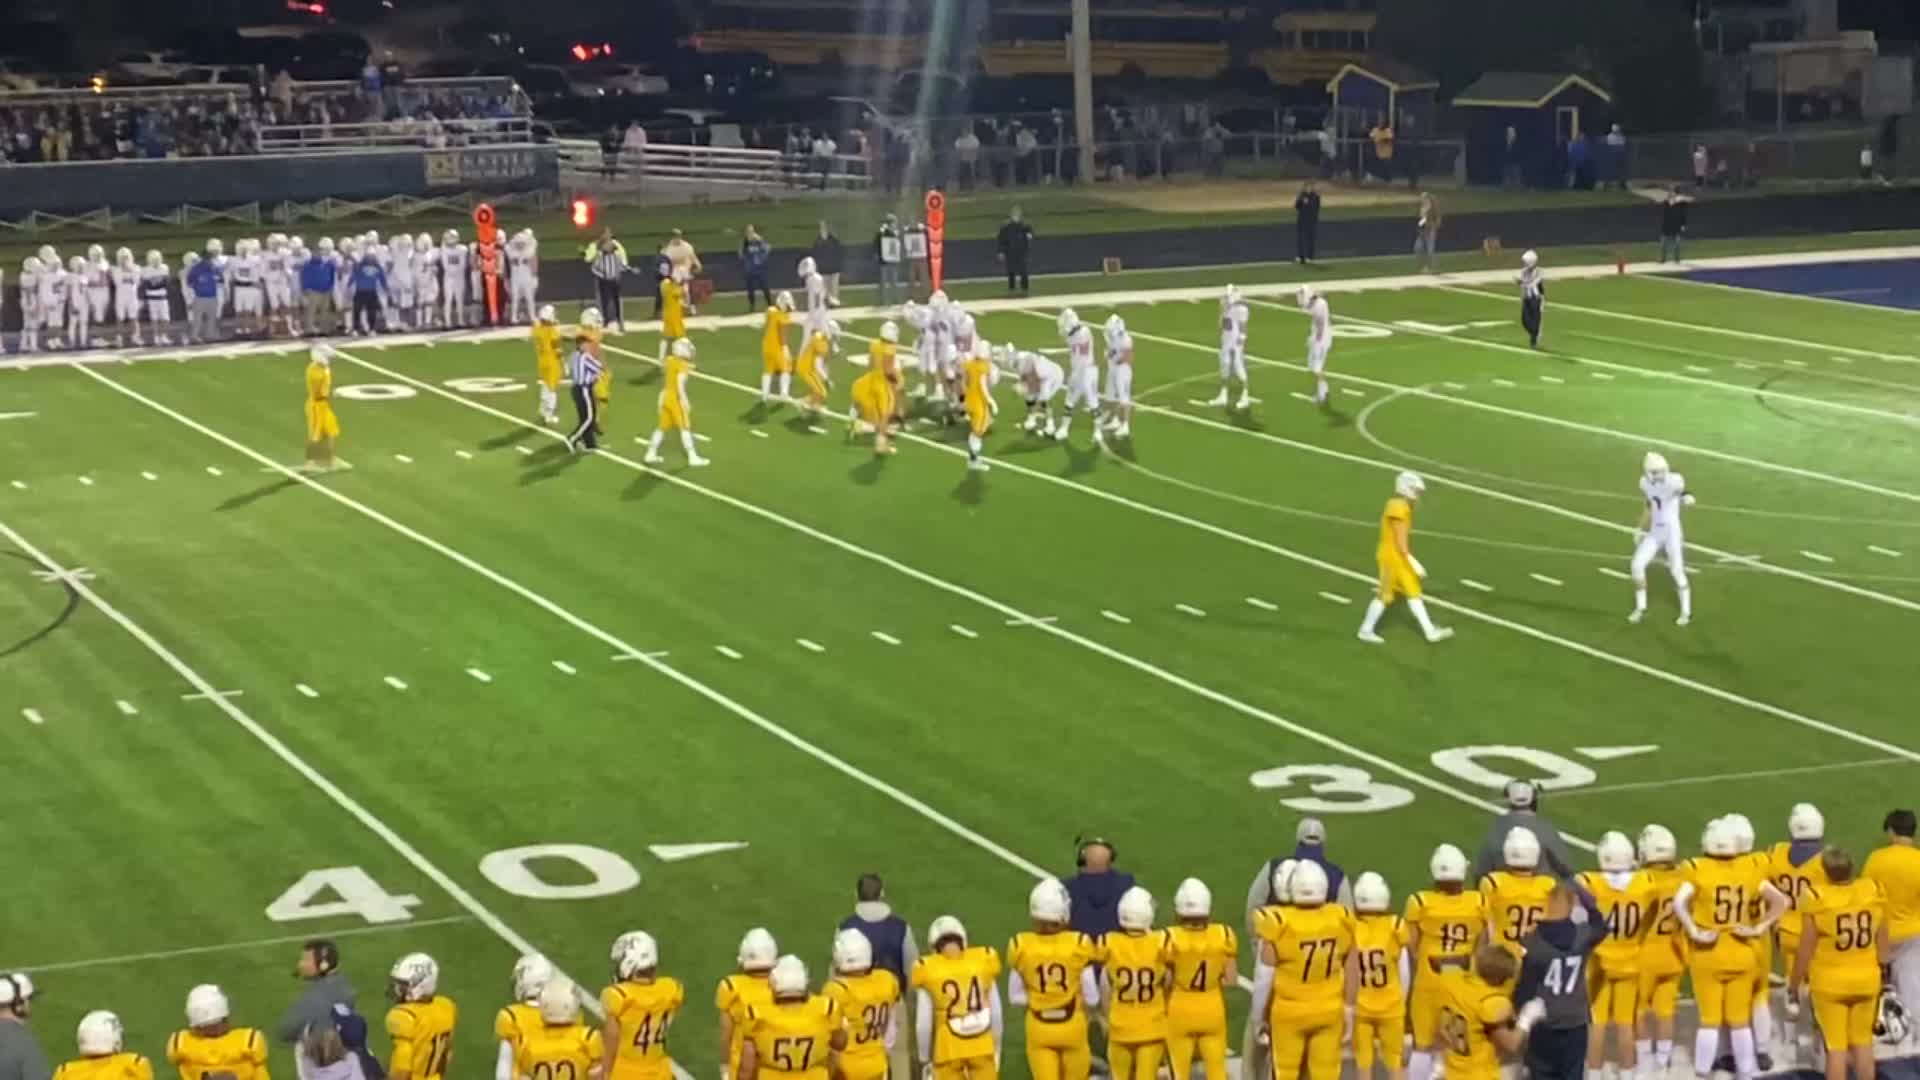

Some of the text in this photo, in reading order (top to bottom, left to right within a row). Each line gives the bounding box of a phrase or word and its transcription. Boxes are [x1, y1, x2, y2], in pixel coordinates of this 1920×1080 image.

[1249, 744, 1597, 814] 30
[265, 843, 641, 923] 40
[1604, 901, 1639, 940] 40
[1714, 885, 1743, 924] 51
[1835, 910, 1871, 951] 58
[1036, 963, 1067, 993] 13
[1190, 961, 1206, 992] 4
[1299, 938, 1336, 983] 77
[1544, 956, 1582, 995] 47
[942, 976, 982, 1020] 24
[1116, 968, 1154, 1003] 28
[633, 1012, 669, 1055] 44
[773, 1037, 814, 1071] 57
